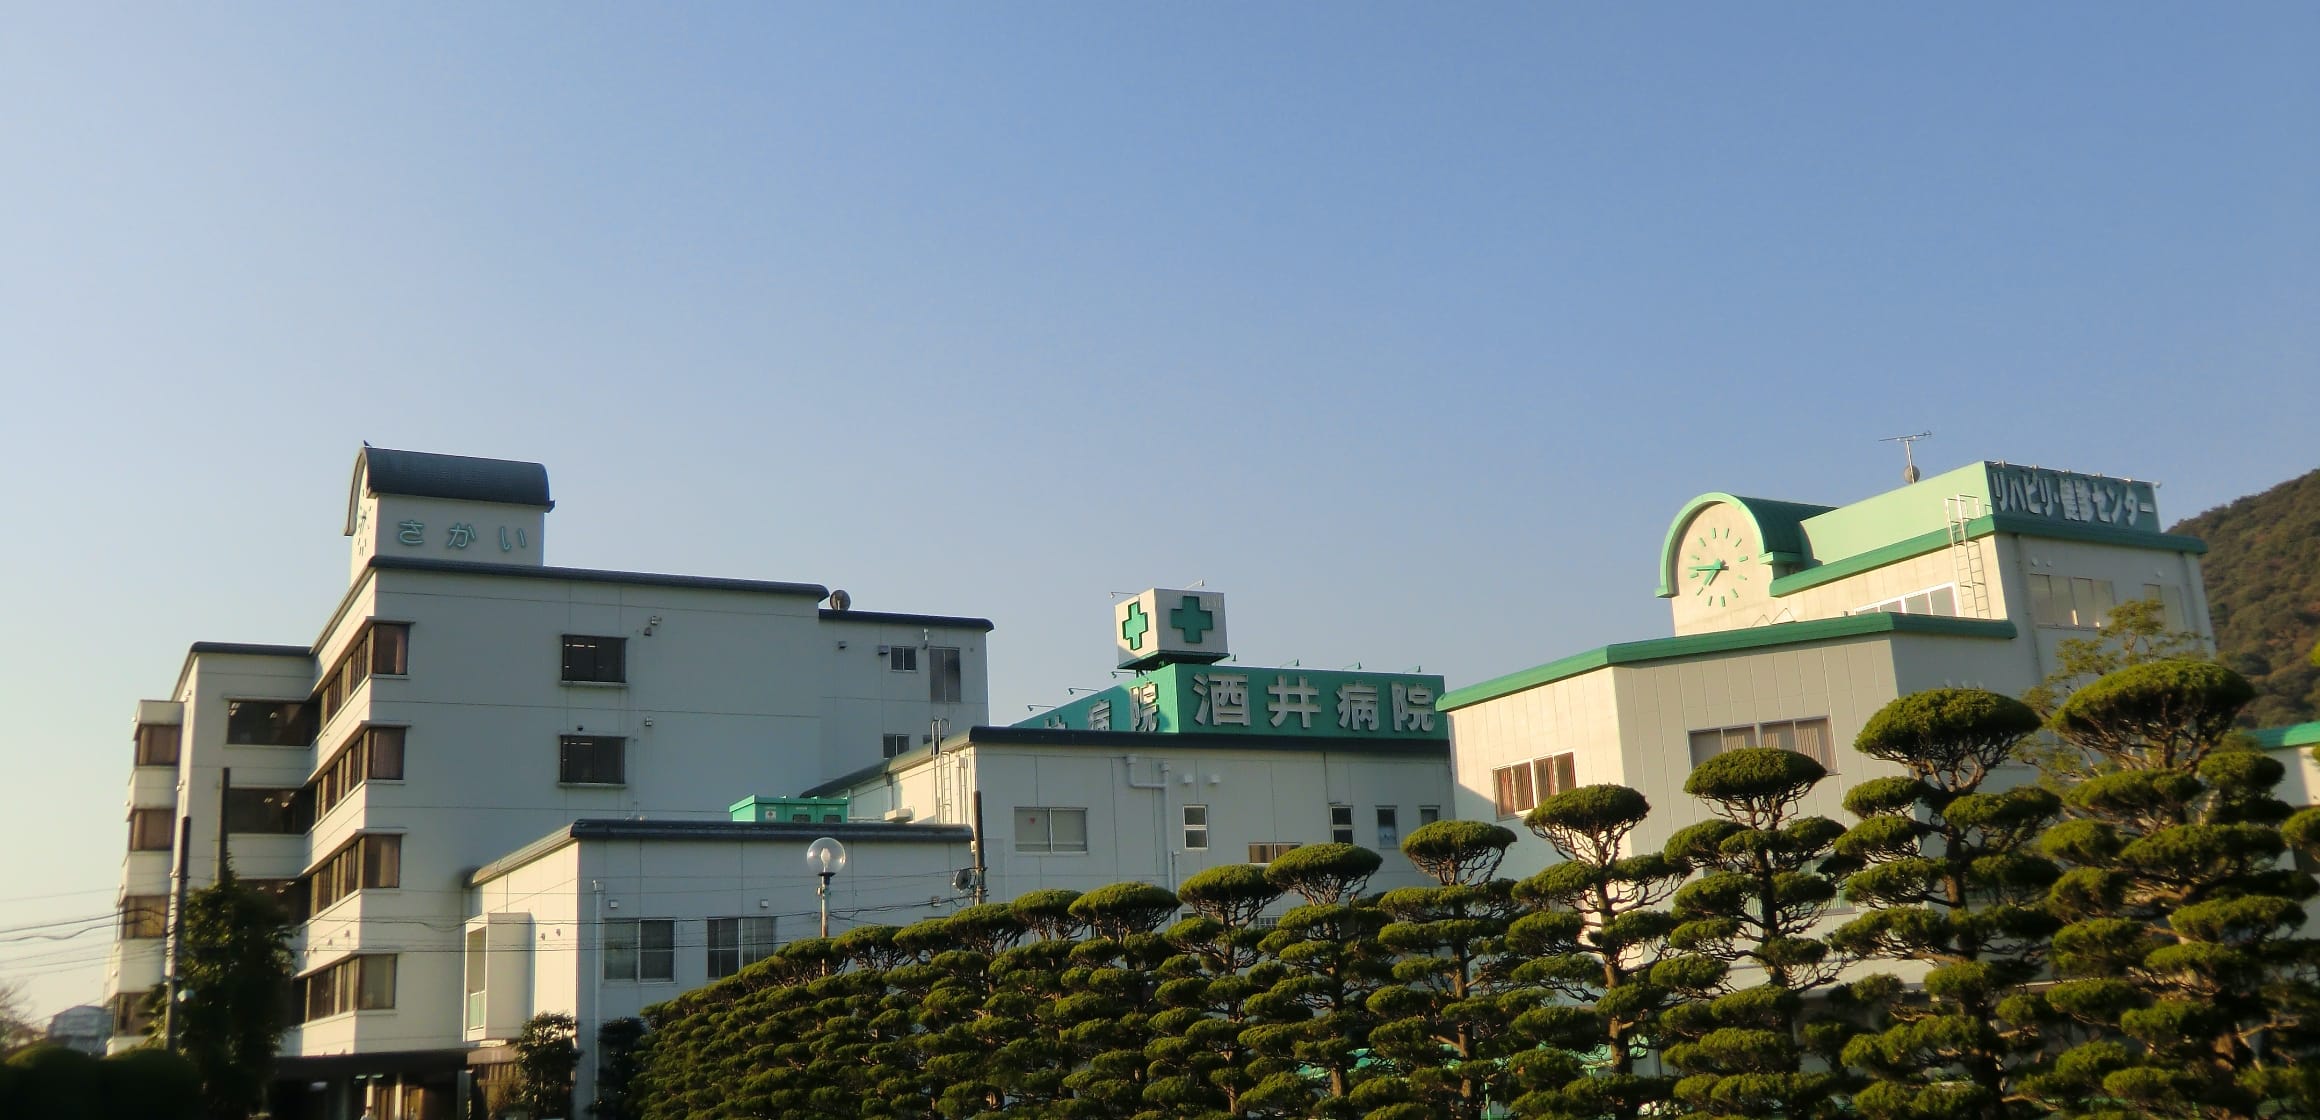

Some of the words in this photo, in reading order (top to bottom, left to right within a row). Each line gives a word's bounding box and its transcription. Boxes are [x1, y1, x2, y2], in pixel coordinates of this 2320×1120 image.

[399, 519, 527, 552] さかい
[1193, 672, 1436, 732] 酒井病院
